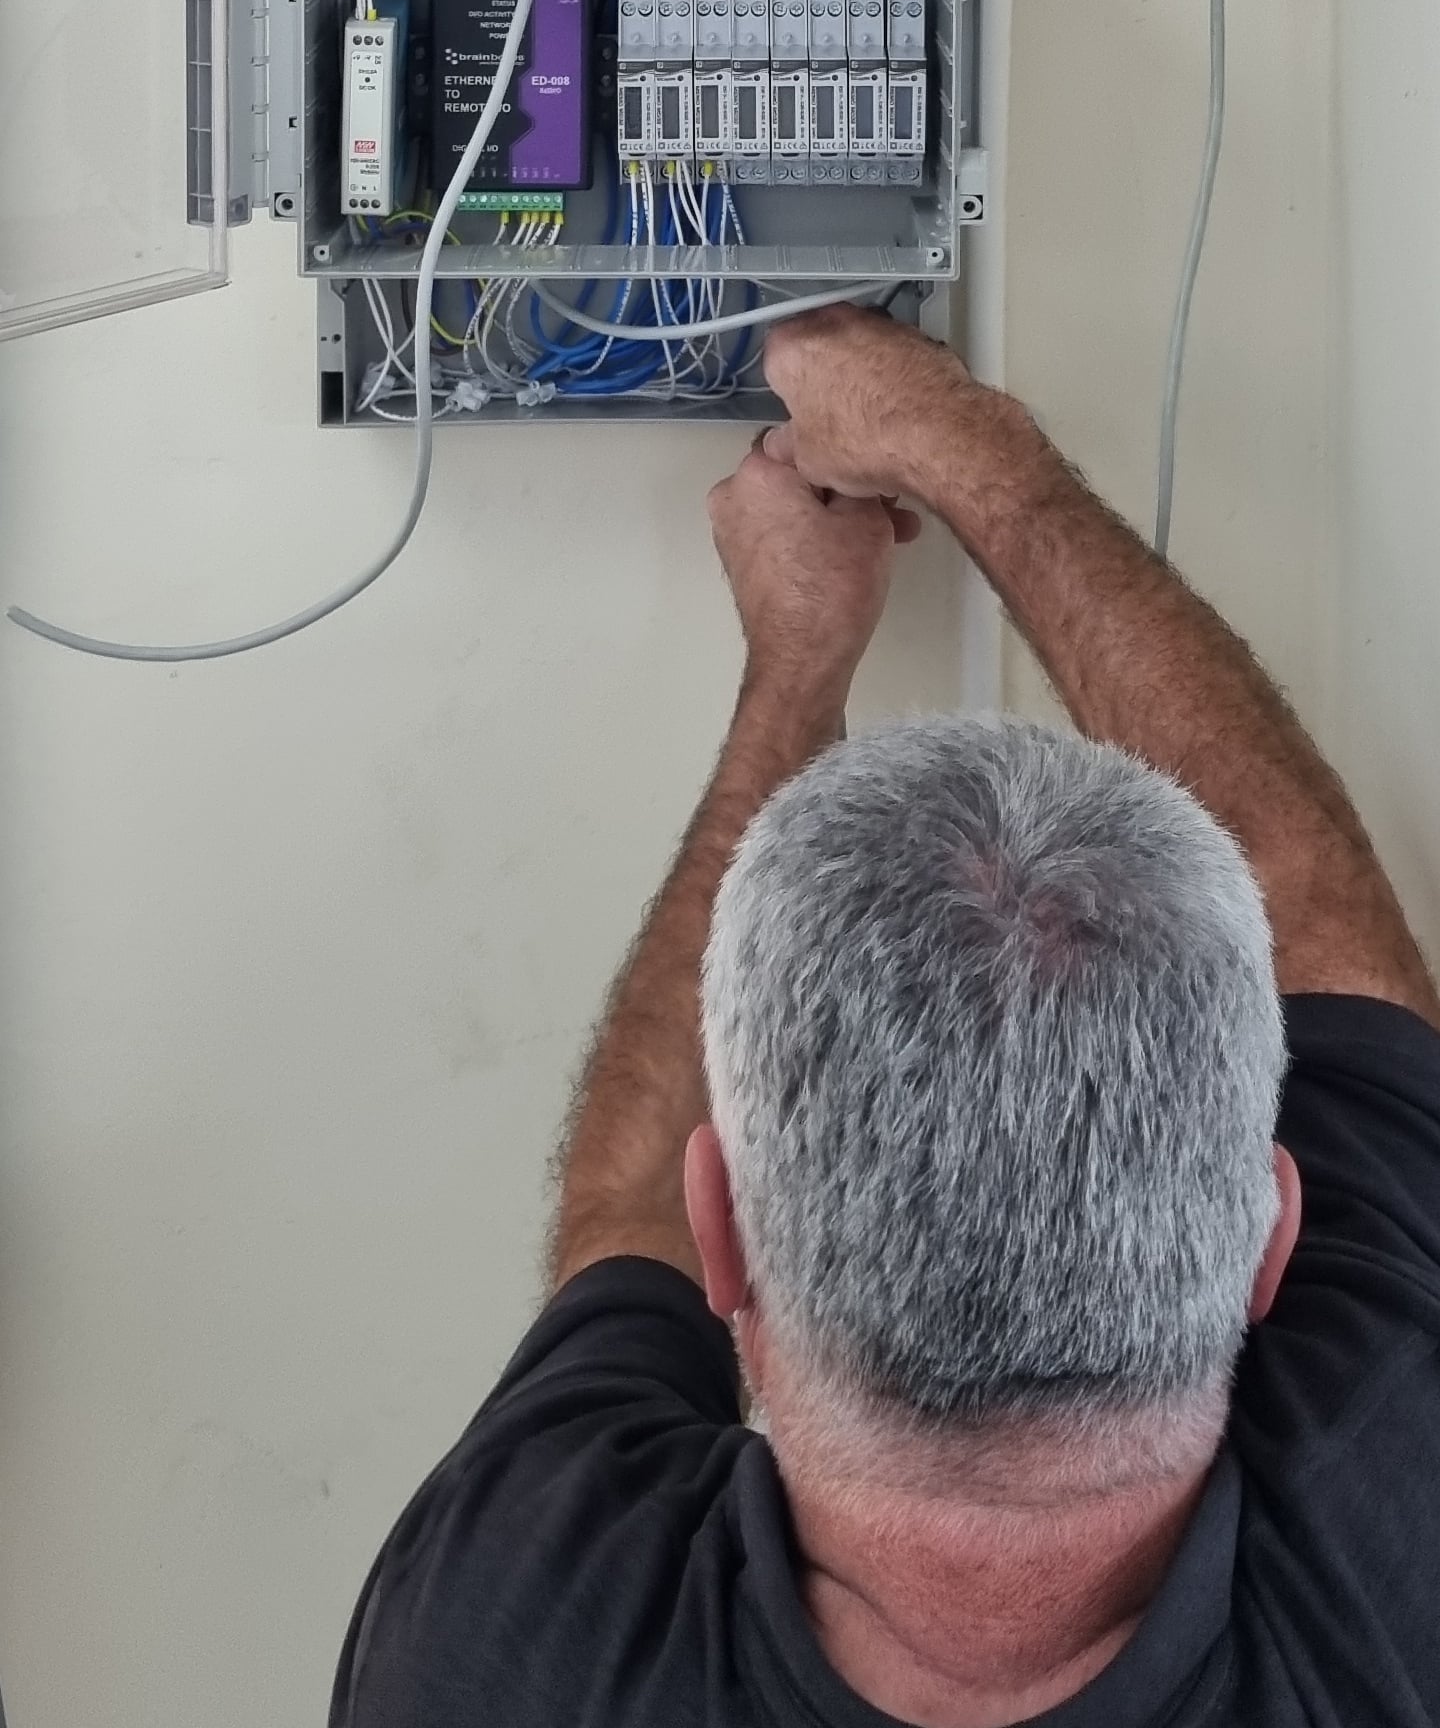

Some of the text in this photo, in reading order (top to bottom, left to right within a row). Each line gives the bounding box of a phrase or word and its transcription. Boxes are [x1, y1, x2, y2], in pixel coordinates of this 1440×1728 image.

[531, 76, 570, 86] ED-008
[445, 89, 461, 99] TO
[444, 103, 486, 113] REMOT
